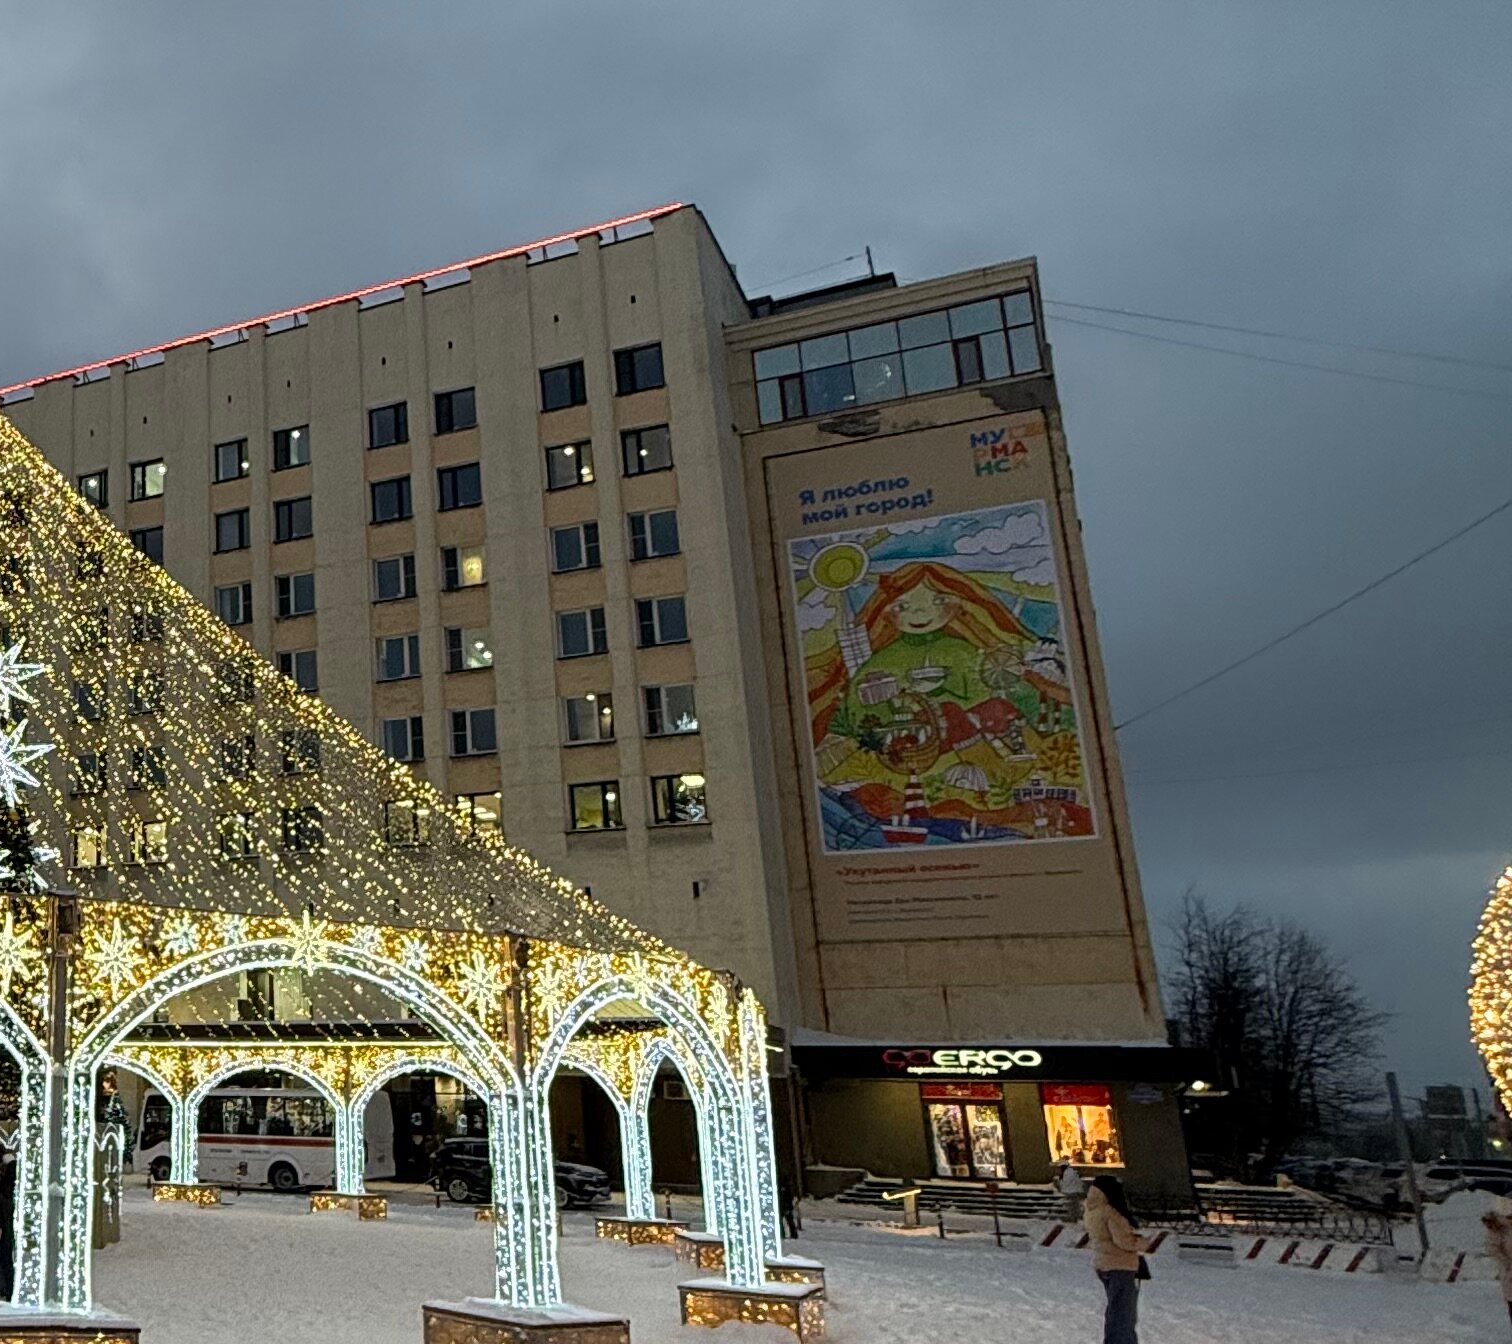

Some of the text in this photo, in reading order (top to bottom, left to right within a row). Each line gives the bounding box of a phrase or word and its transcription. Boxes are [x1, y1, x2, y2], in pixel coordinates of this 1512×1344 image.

[970, 428, 1005, 448] МУ
[799, 476, 910, 505] Я люблю
[802, 489, 934, 525] мой город!
